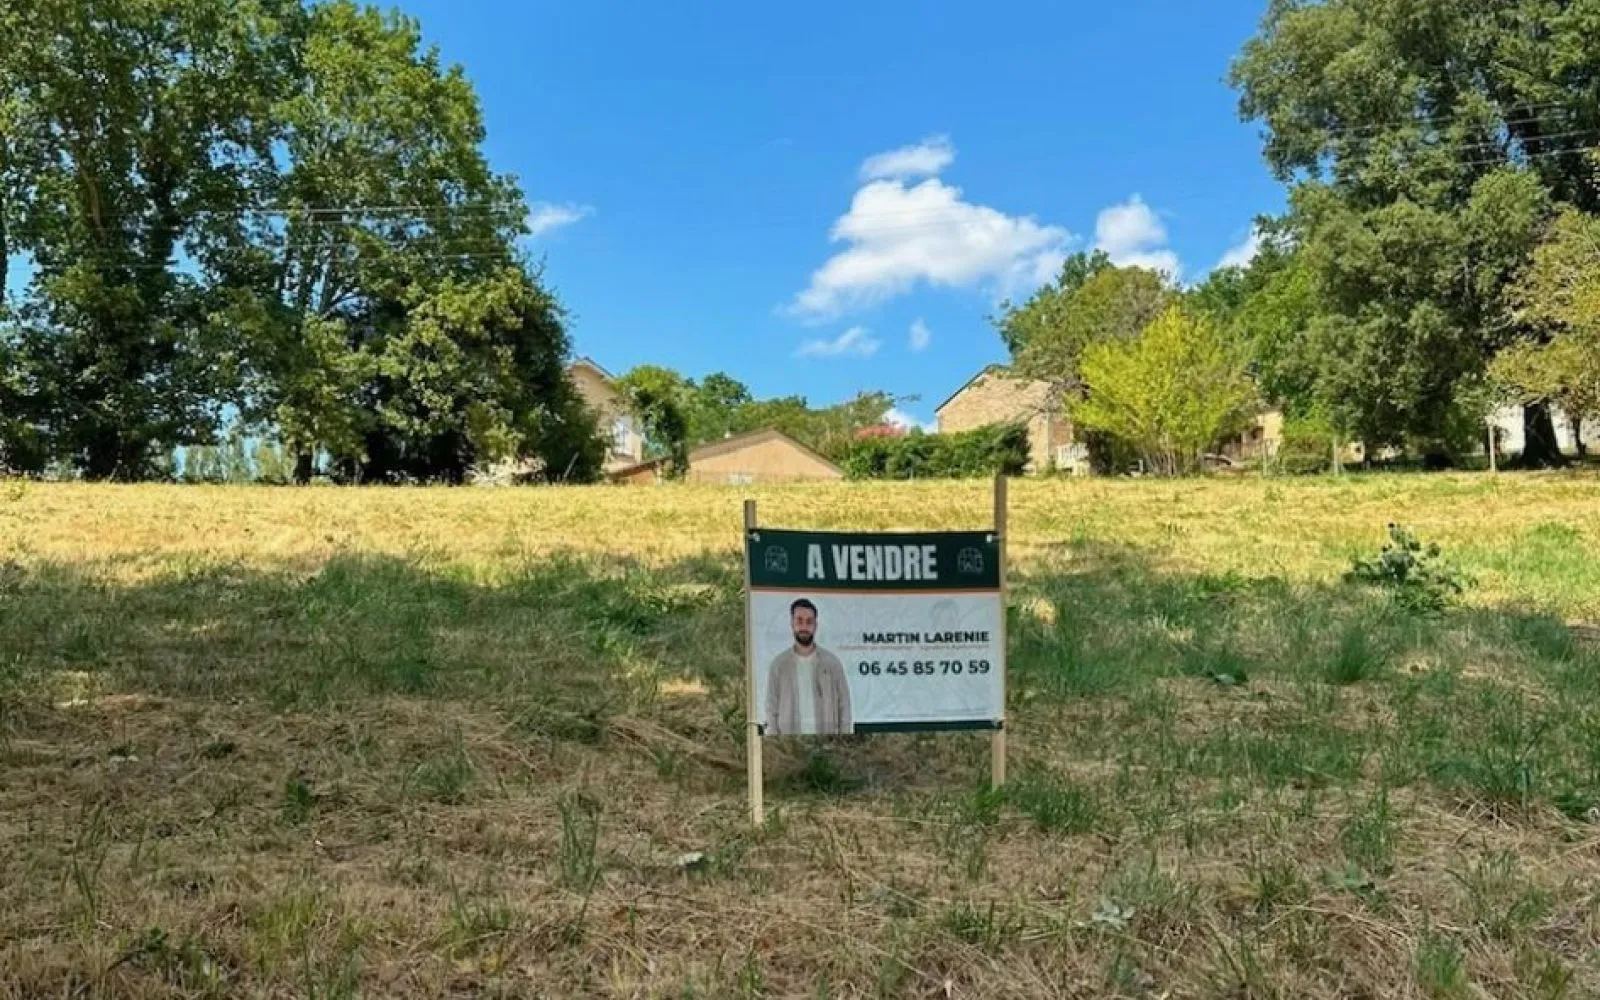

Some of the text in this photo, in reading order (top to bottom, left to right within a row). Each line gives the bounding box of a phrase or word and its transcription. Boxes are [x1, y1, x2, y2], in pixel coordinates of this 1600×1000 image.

[807, 543, 938, 581] A VENDRE
[862, 630, 990, 644] MARTIN LARENIE
[859, 659, 990, 676] 06 45 85 70 59
